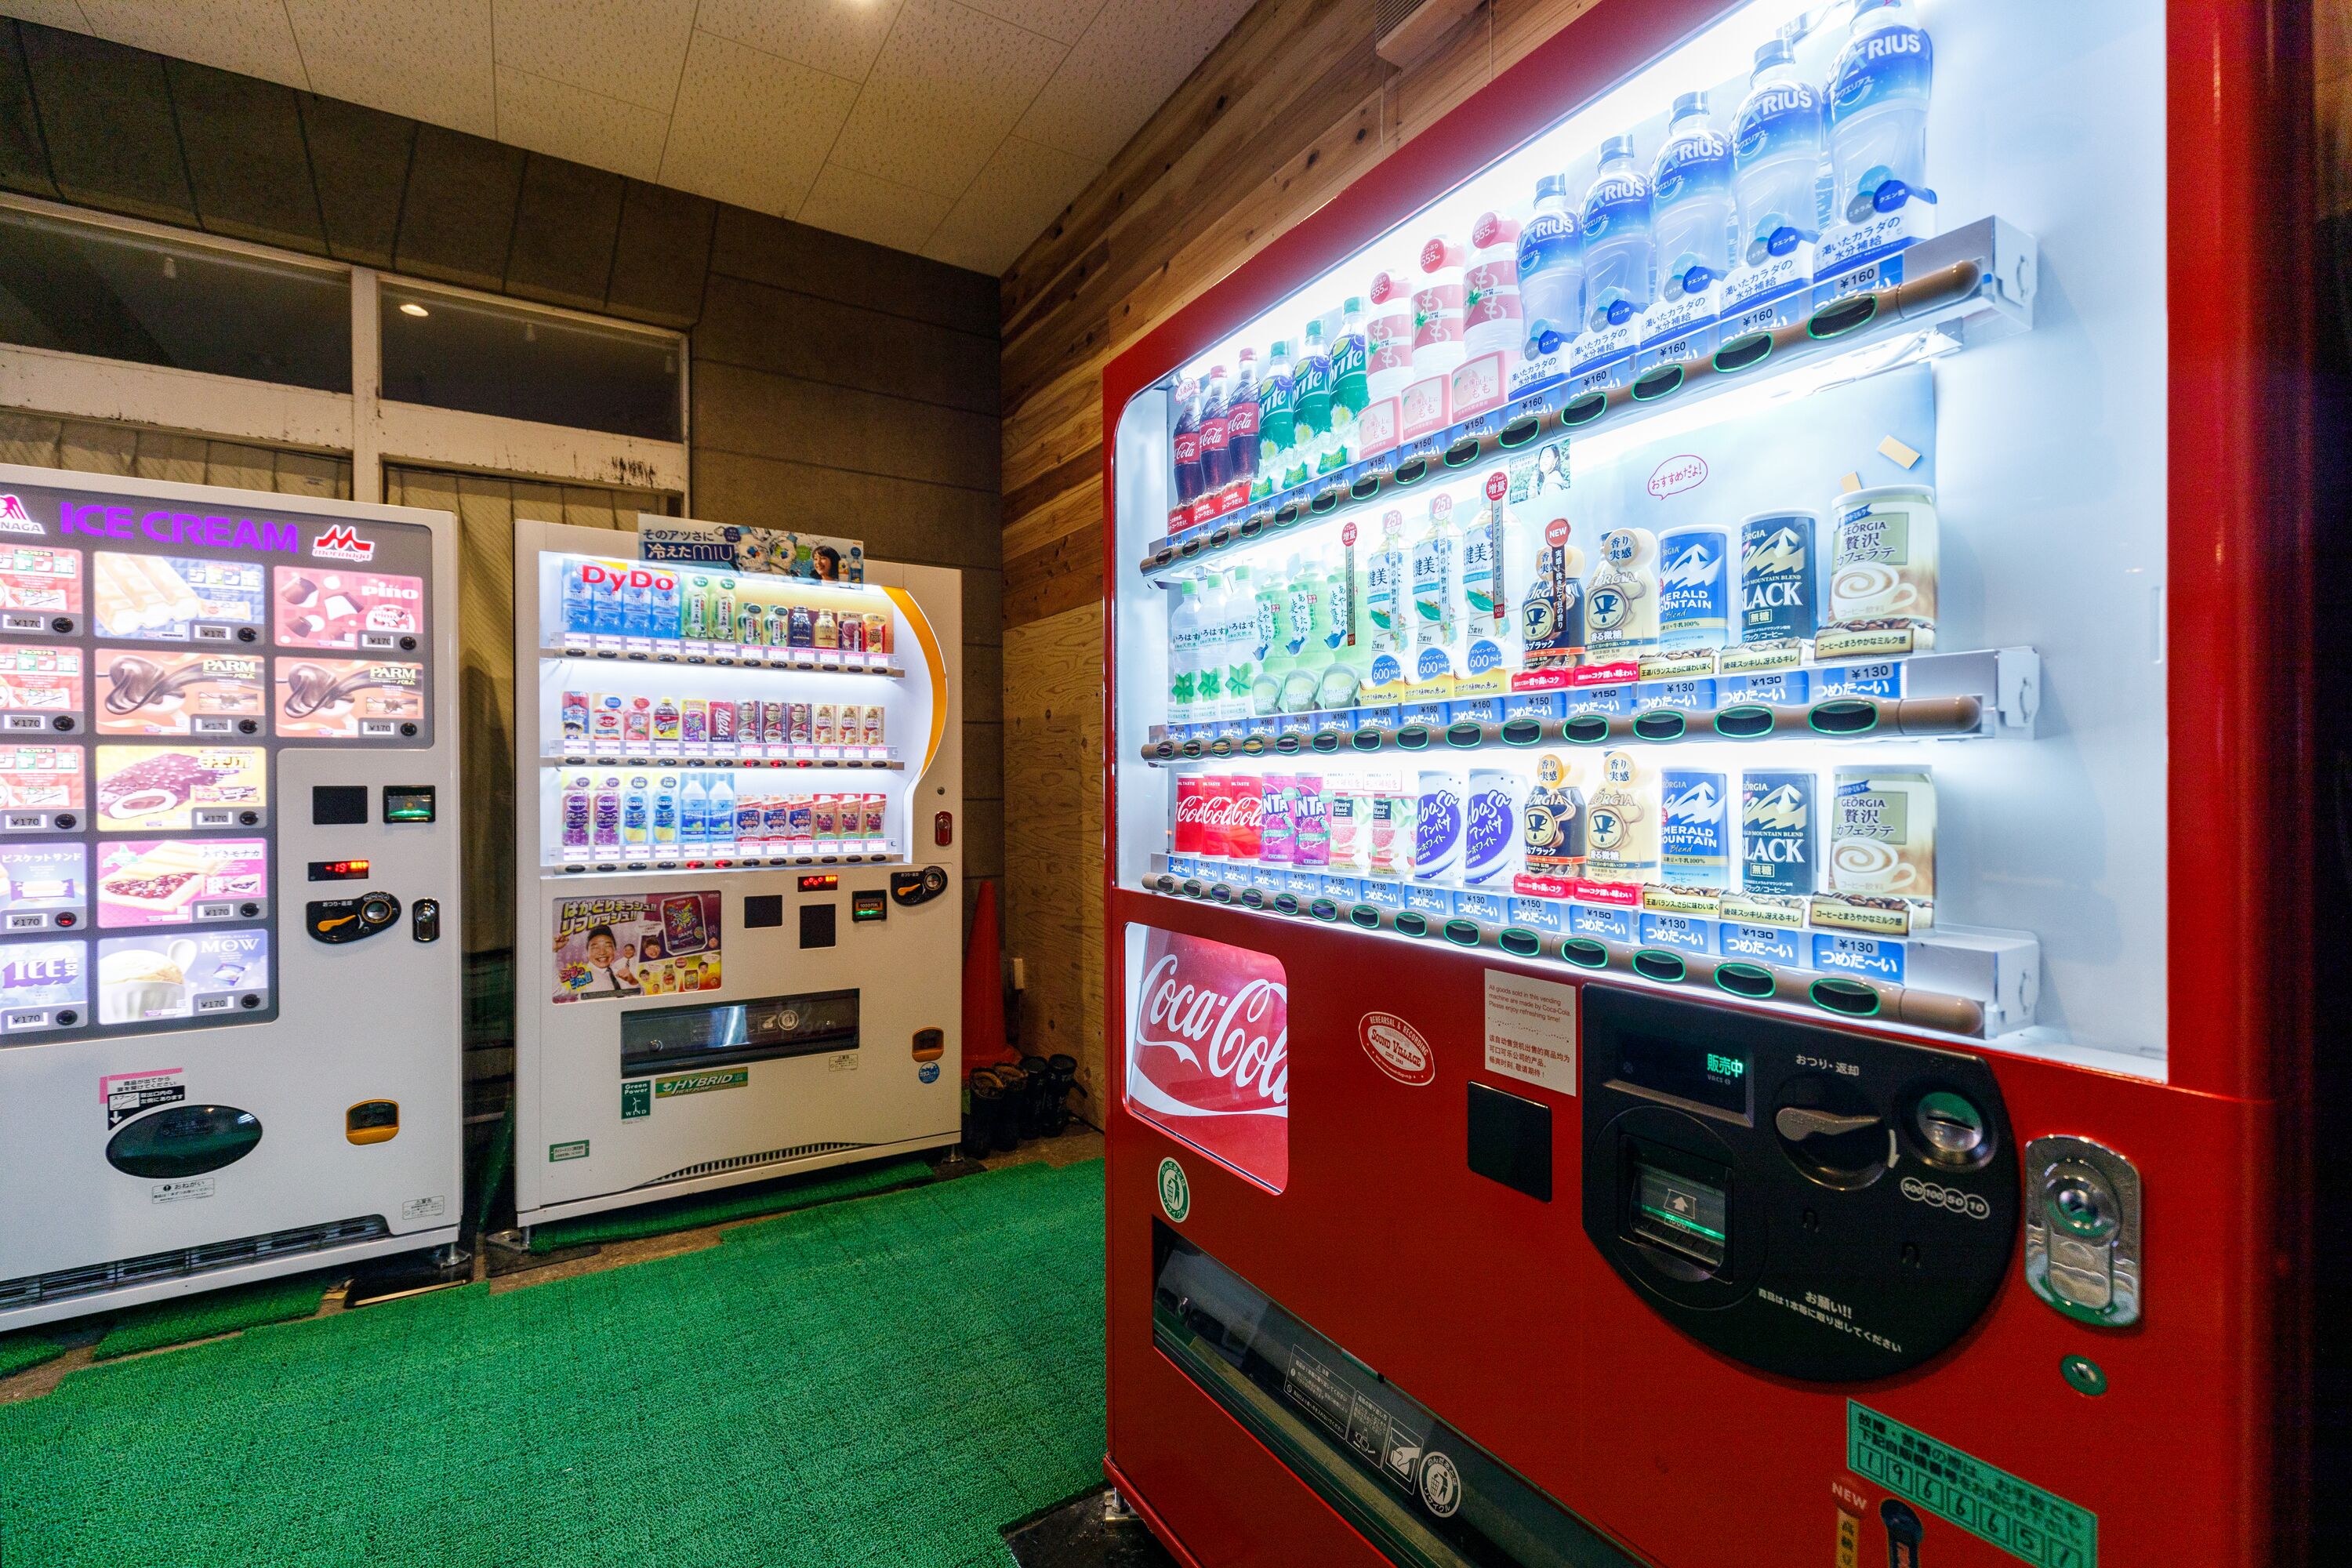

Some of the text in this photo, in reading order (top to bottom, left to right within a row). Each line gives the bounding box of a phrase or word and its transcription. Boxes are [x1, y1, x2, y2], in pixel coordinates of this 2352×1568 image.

[1834, 234, 1883, 261] 水分補給
[1735, 276, 1777, 302] 水分補給
[1654, 311, 1692, 334] 水分補給
[1582, 343, 1615, 361] 水分補給
[1518, 369, 1546, 387] 水分補給
[1584, 371, 1606, 387] ¥160
[1523, 397, 1542, 409] ¥160
[1414, 437, 1432, 449] ¥150
[1370, 456, 1385, 466] ¥150
[1330, 474, 1343, 483] ¥160
[1651, 463, 1703, 490] おすすめだよ!
[1293, 488, 1305, 496] ¥160
[1488, 481, 1506, 495] 増量
[1259, 500, 1269, 509] ¥160
[61, 502, 298, 554] ICE CREAM
[643, 528, 714, 542] そのアツさに
[1549, 526, 1568, 539] NEW
[1341, 532, 1357, 542] 増量
[1610, 535, 1630, 548] 香り
[1845, 532, 1880, 550] 贅沢
[314, 549, 371, 561] morinaga
[648, 543, 692, 560] 冷えた
[1610, 547, 1632, 561] 実感
[1836, 547, 1896, 566] カフェラテ
[583, 564, 673, 591] DyDo
[1749, 574, 1802, 585] MOUNTAIN BLEND
[361, 581, 419, 599] pino
[1665, 610, 1687, 620] Blend
[1749, 612, 1772, 624] 無糖
[1591, 632, 1623, 642] 香る微糖
[203, 660, 256, 671] PARM
[370, 666, 416, 678] PARM
[1852, 666, 1889, 680] ¥130
[1667, 682, 1694, 693] ¥130
[1751, 675, 1781, 686] ¥130
[1592, 689, 1617, 699] ¥150
[1529, 697, 1549, 706] ¥150
[1541, 759, 1556, 770] 香り
[1610, 758, 1628, 770] 香り
[1540, 770, 1558, 782] 実感
[1609, 769, 1631, 782] 実感
[1841, 797, 1886, 808] GEORGIA
[1844, 809, 1879, 824] 贅沢
[1420, 817, 1452, 837] アンバサ
[1469, 815, 1503, 839] アンバサ
[1836, 824, 1895, 838] カフェラテ
[1590, 850, 1621, 862] 香る微糖
[1669, 845, 1693, 854] Blend
[2, 853, 82, 863] ビスケットサンド
[1751, 865, 1773, 877] 無糖
[1331, 877, 1345, 886] ¥130
[1372, 882, 1387, 891] ¥130
[1417, 888, 1433, 897] ¥130
[1467, 895, 1485, 904] ¥130
[1521, 898, 1541, 908] ¥150
[1587, 909, 1612, 920] ¥150
[561, 910, 637, 936] リフレッシュ!!
[1660, 916, 1686, 930] ¥130
[201, 938, 259, 953] MOW
[14, 959, 64, 980] ICE
[1490, 993, 1509, 1003] machine
[1519, 999, 1534, 1008] made
[1496, 986, 1511, 996] goods
[1541, 996, 1561, 1007] vending
[1490, 1000, 1504, 1010] Please
[1505, 1004, 1519, 1014] enjoy
[1519, 1008, 1546, 1021] refreshing
[1370, 1016, 1396, 1028] REHEARSAL
[1403, 1025, 1428, 1057] RECORDING
[1490, 1035, 1570, 1063] 该自动售货机出售的商品均为
[1707, 1053, 1744, 1078] 販売中
[1795, 1054, 1860, 1077] おつり・返却
[671, 1075, 733, 1094] HYBRID
[1161, 1162, 1186, 1187] のんだあとは
[1904, 1182, 1984, 1213] 500 100 50 10
[1163, 1198, 1185, 1218] リサイクル
[1805, 1290, 1853, 1320] お願い!!
[1427, 1457, 1457, 1486] のんだあとは
[1423, 1486, 1452, 1513] リサイクル
[1831, 1480, 1868, 1512] NEW
